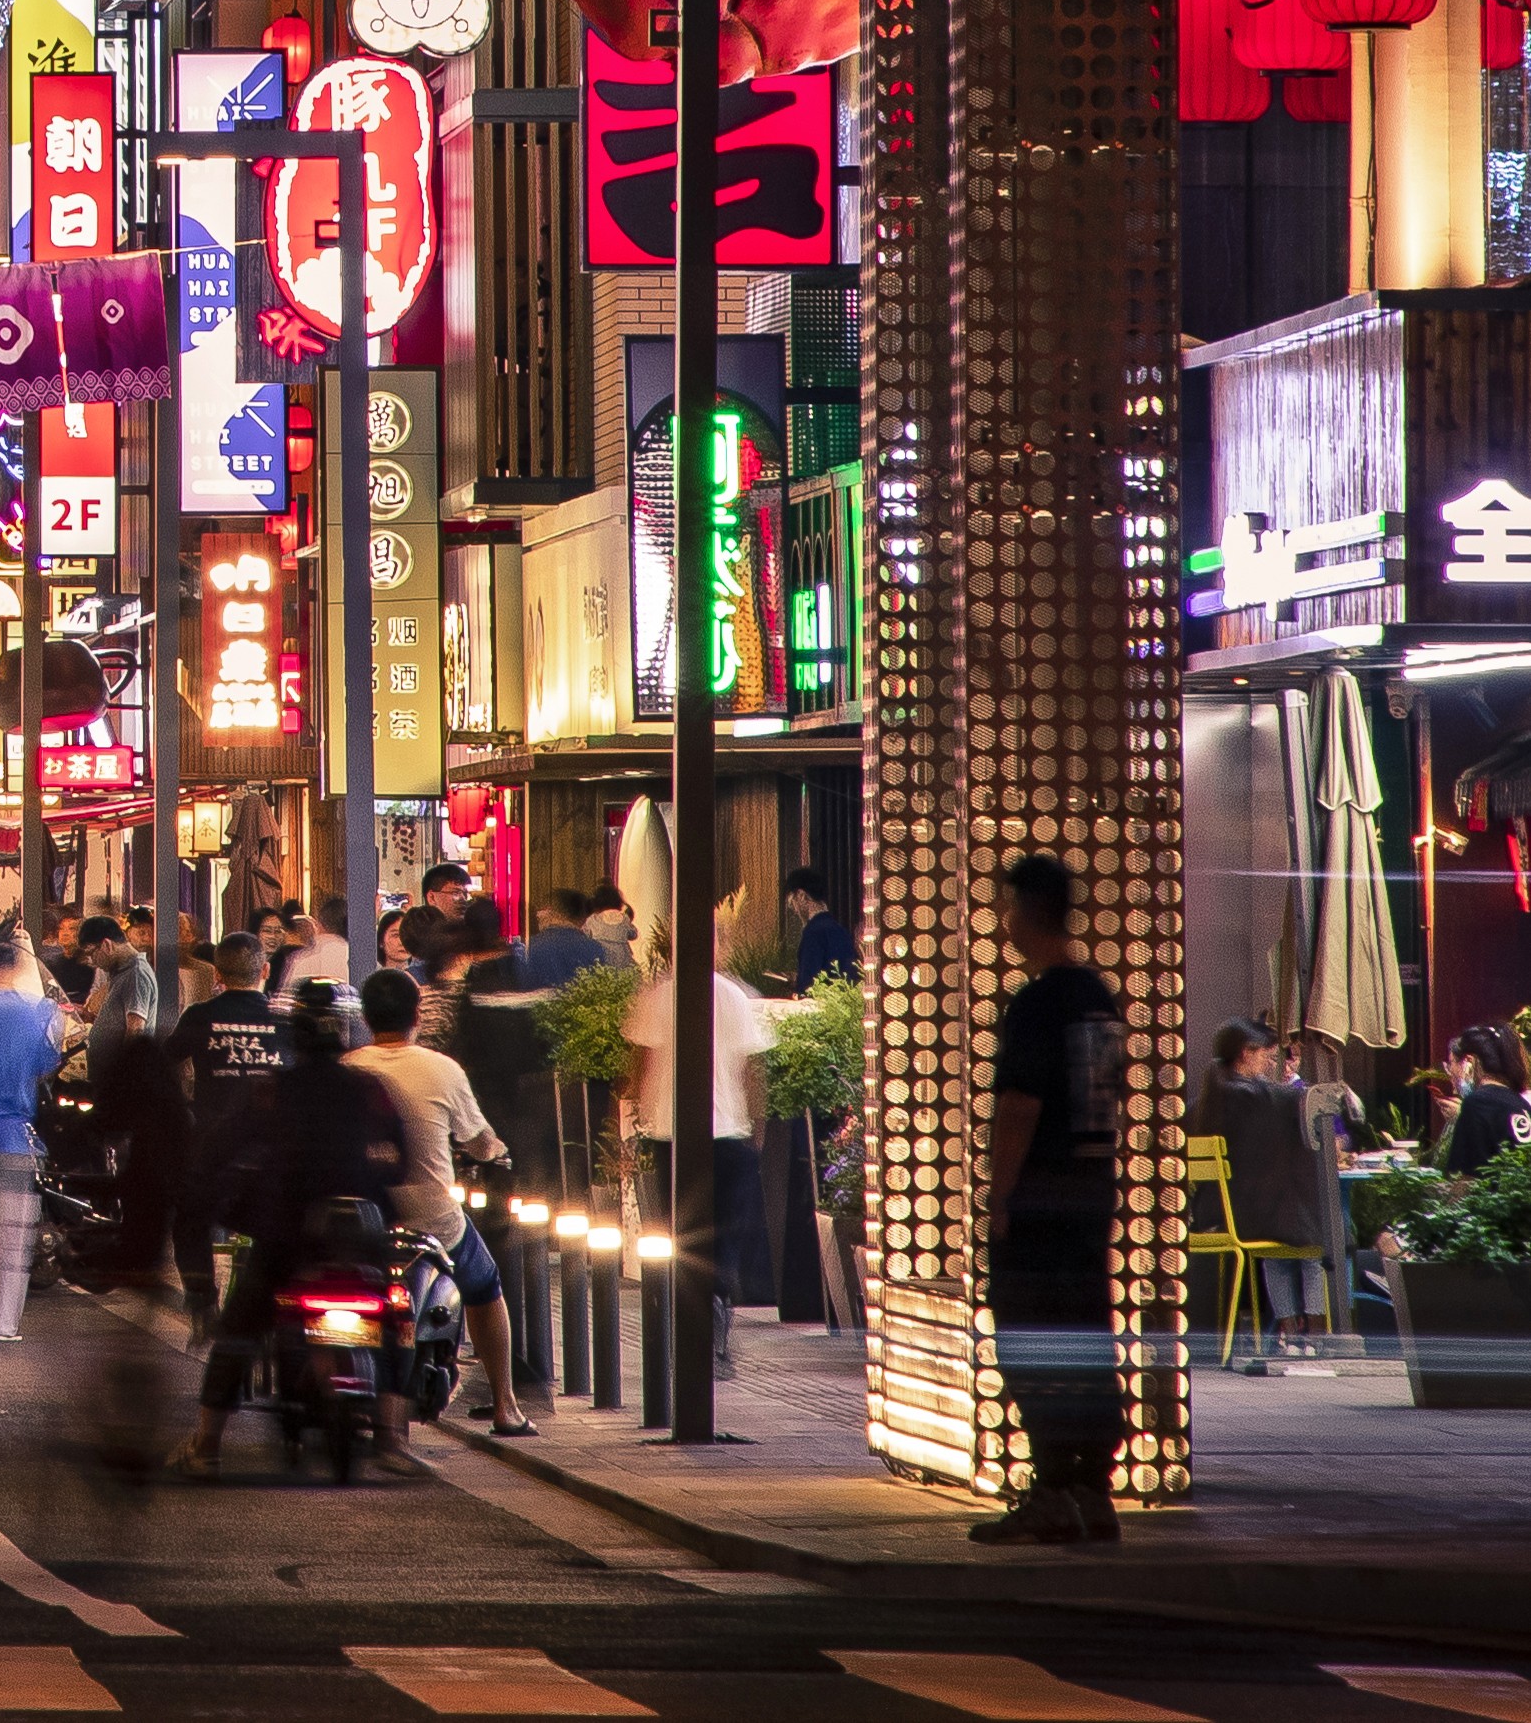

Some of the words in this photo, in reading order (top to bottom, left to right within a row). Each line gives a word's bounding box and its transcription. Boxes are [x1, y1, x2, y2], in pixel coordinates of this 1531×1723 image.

[45, 115, 103, 249] 朝日
[188, 254, 231, 269] HUA
[188, 280, 230, 296] HAI
[190, 455, 273, 472] STREET
[51, 499, 101, 531] 2F
[1440, 479, 1531, 582] 全
[45, 754, 119, 779] お茶屋
[197, 817, 217, 838] 茶
